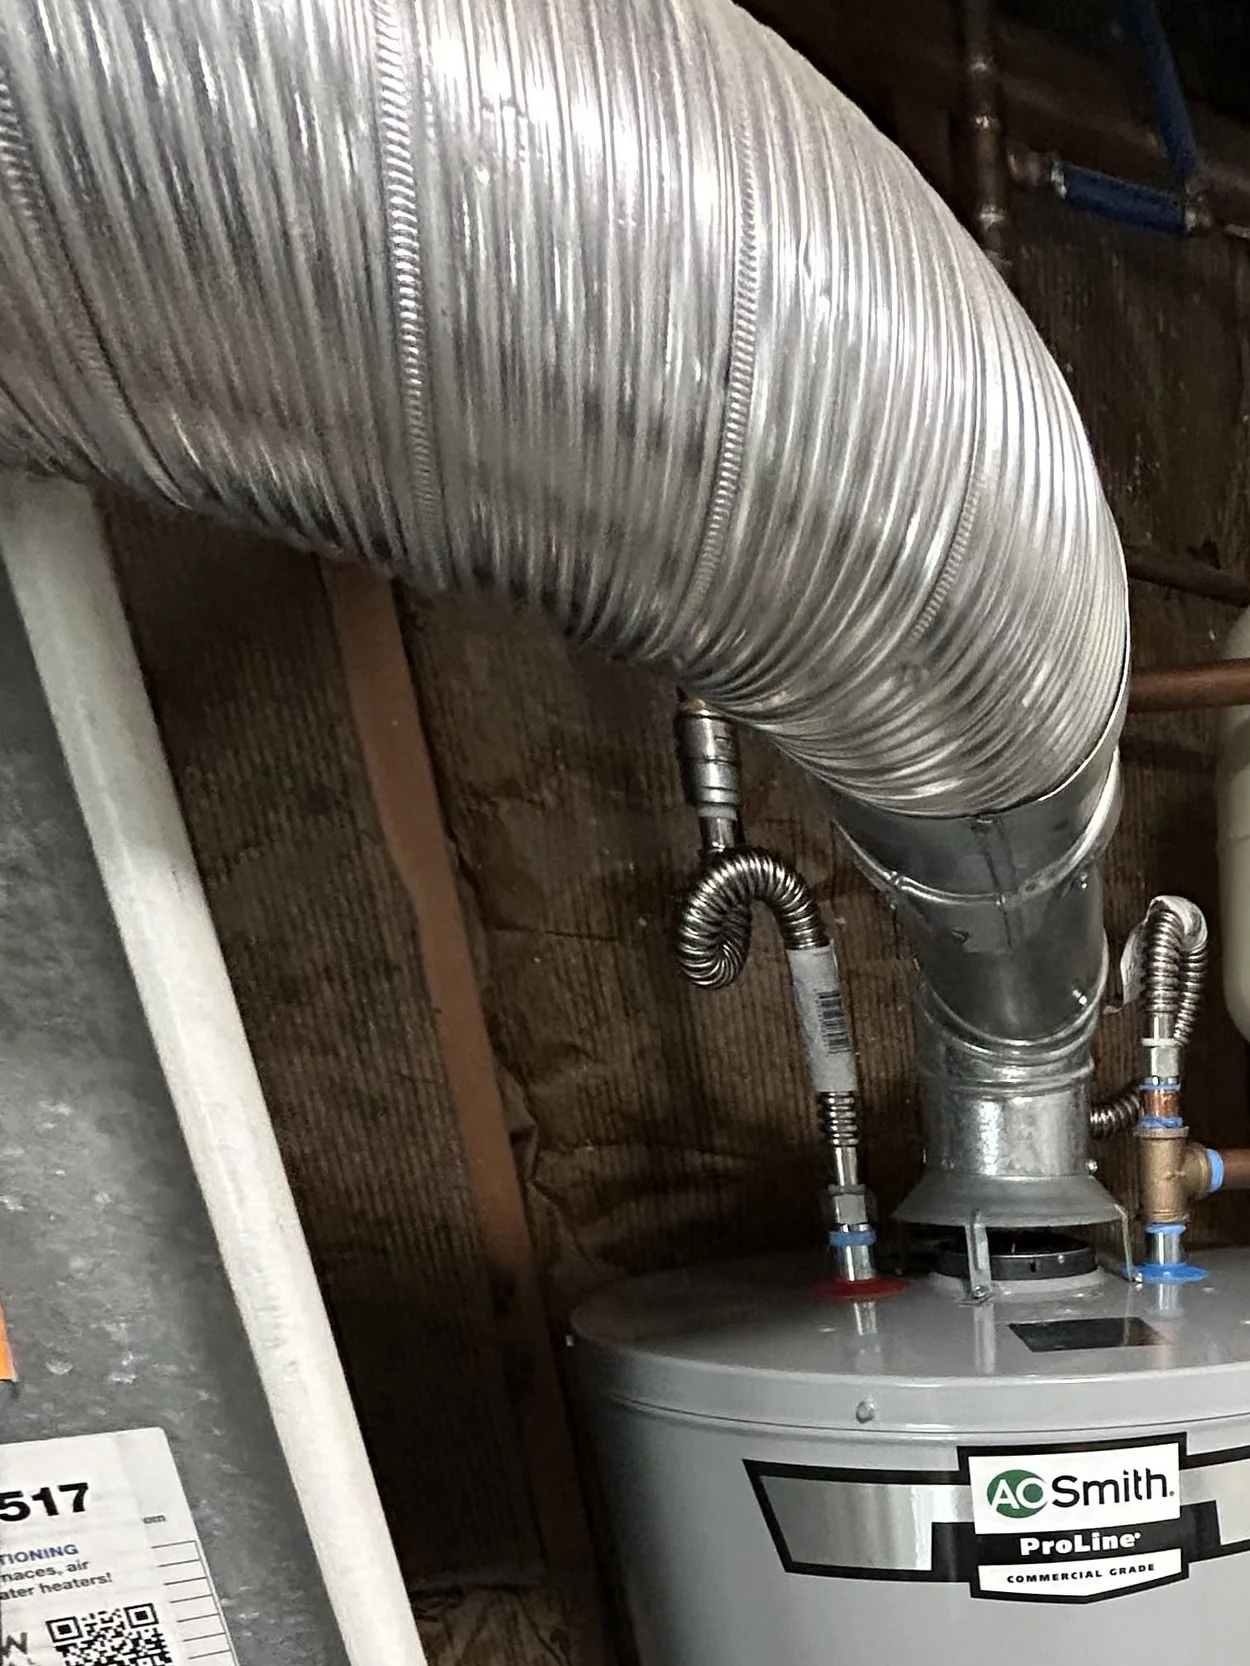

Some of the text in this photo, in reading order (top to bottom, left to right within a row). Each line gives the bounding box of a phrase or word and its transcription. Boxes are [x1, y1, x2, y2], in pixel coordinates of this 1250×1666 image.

[1051, 1468, 1173, 1508] Smith
[0, 1483, 89, 1521] 517
[1019, 1532, 1141, 1556] ProLine
[66, 1559, 89, 1573] air
[1006, 1563, 1155, 1584] COMMERCIAL GRADE
[39, 1571, 113, 1594] heaters!
